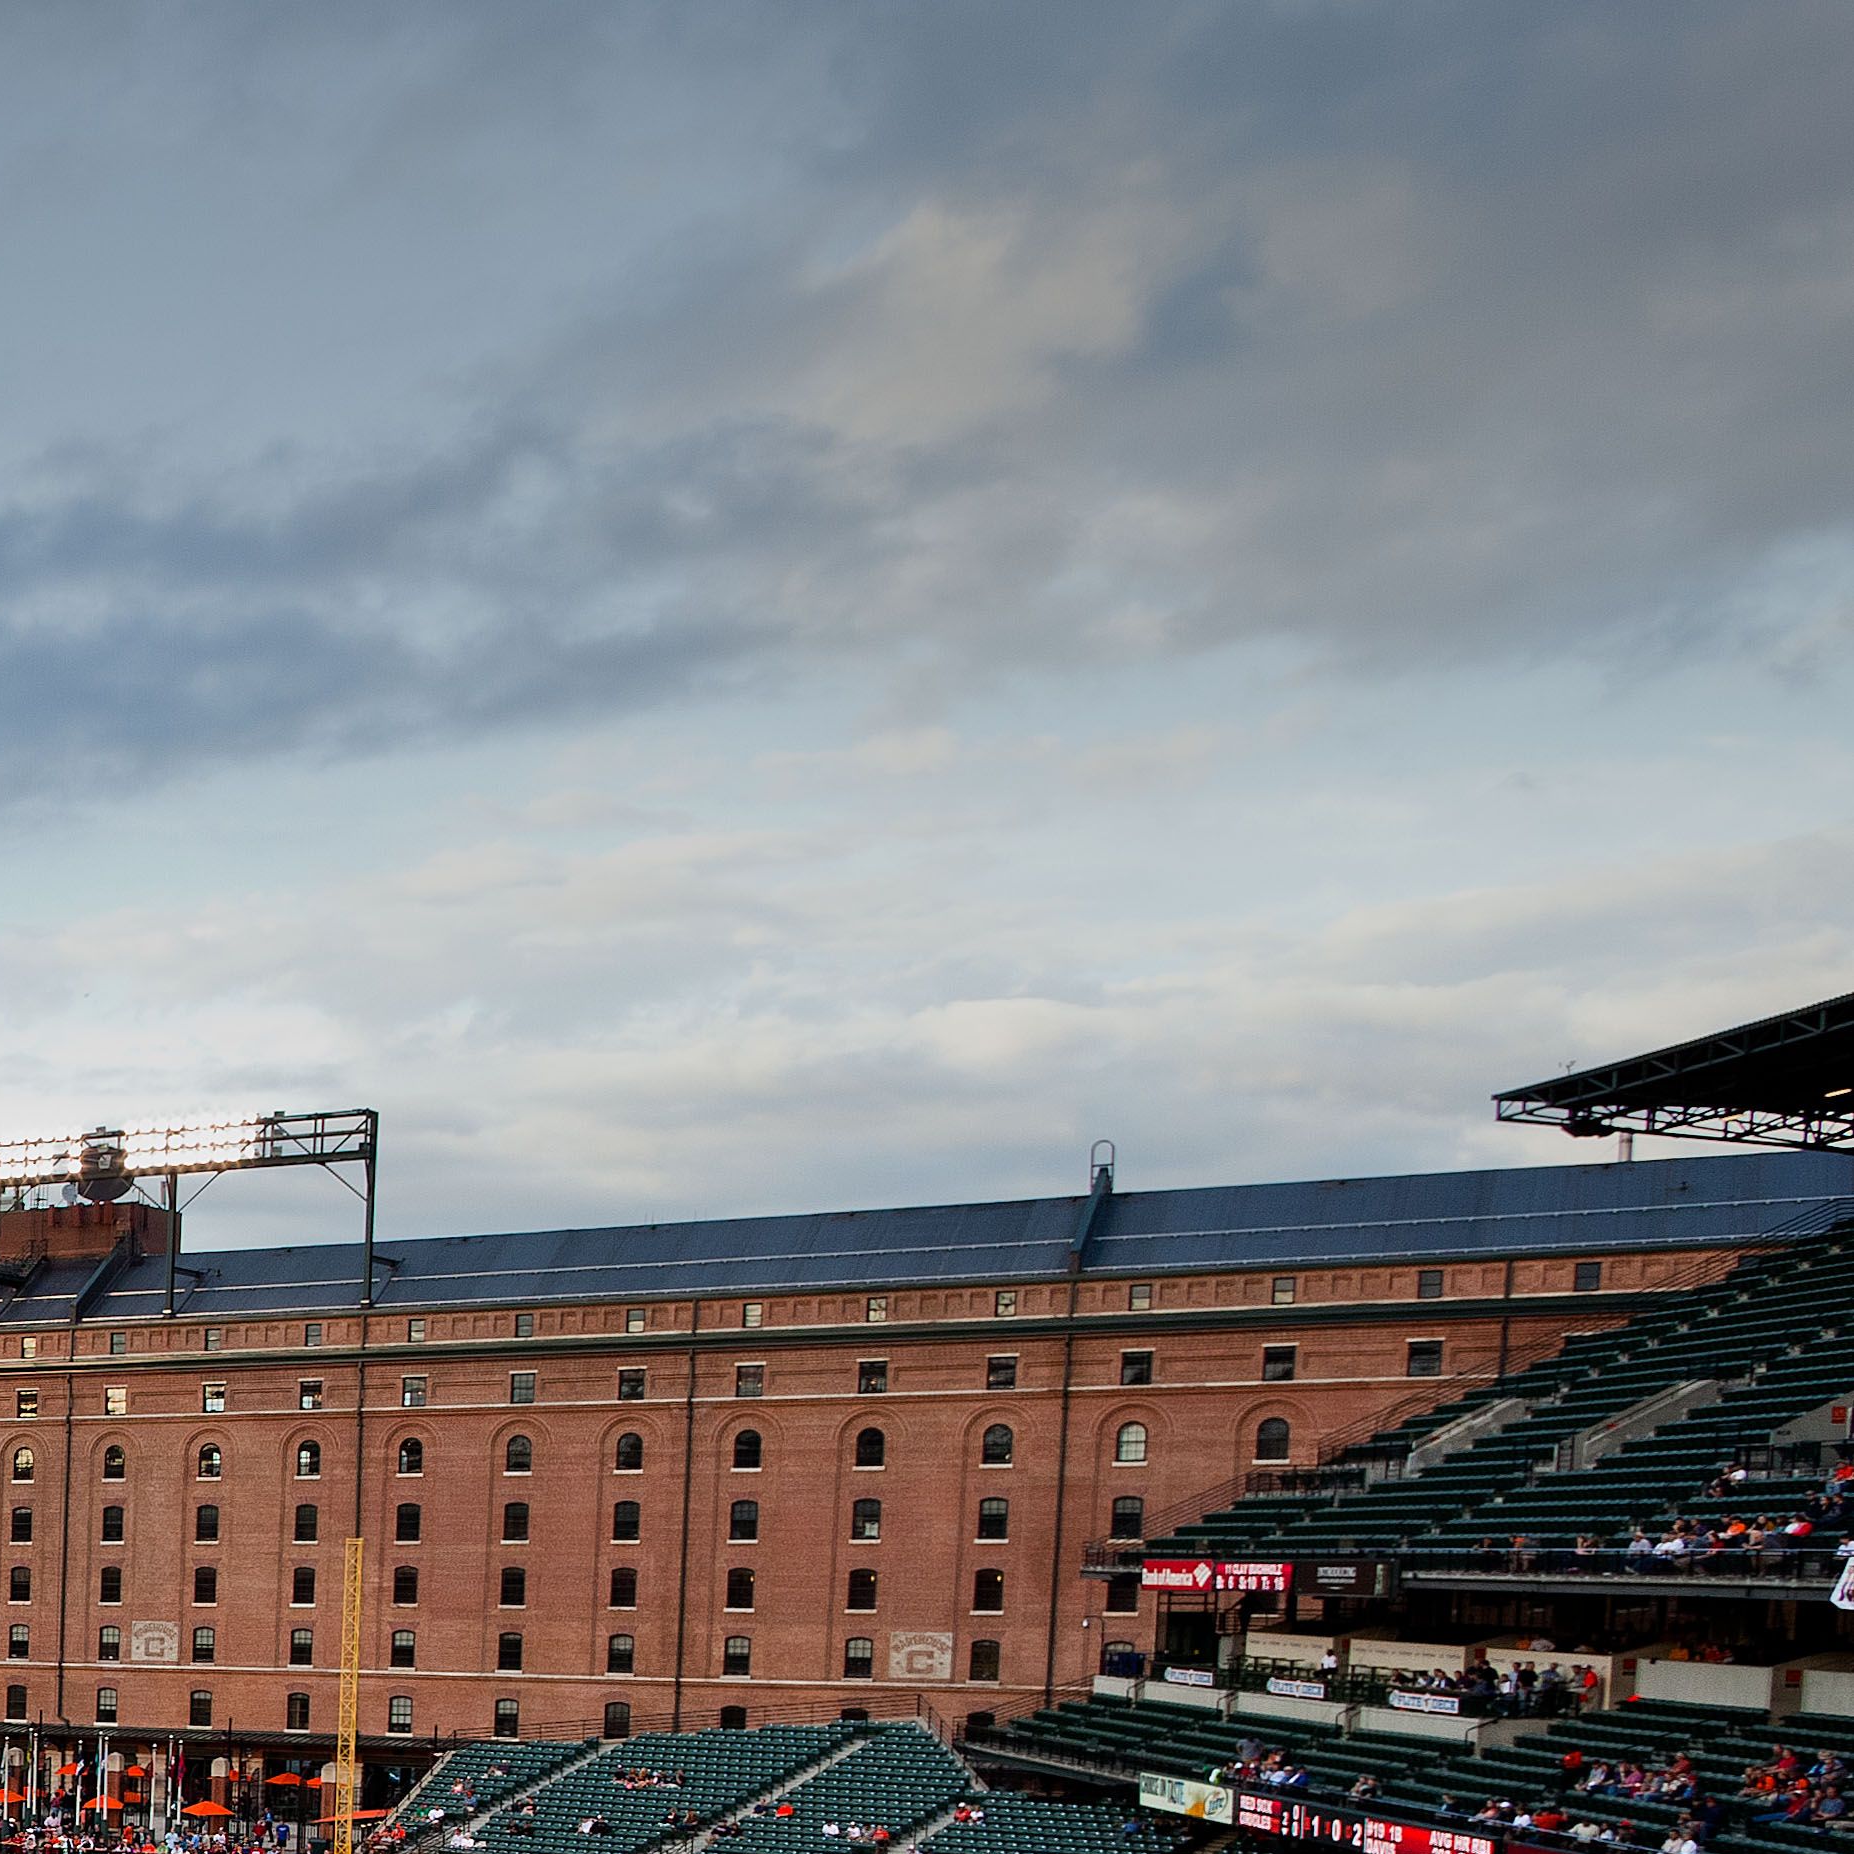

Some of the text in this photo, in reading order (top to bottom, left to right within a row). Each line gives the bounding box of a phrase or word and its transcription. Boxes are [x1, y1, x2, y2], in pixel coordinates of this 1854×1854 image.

[1312, 1816, 1363, 1846] 1 0 2
[1429, 1830, 1452, 1850] AVG
[1454, 1834, 1470, 1851] HR
